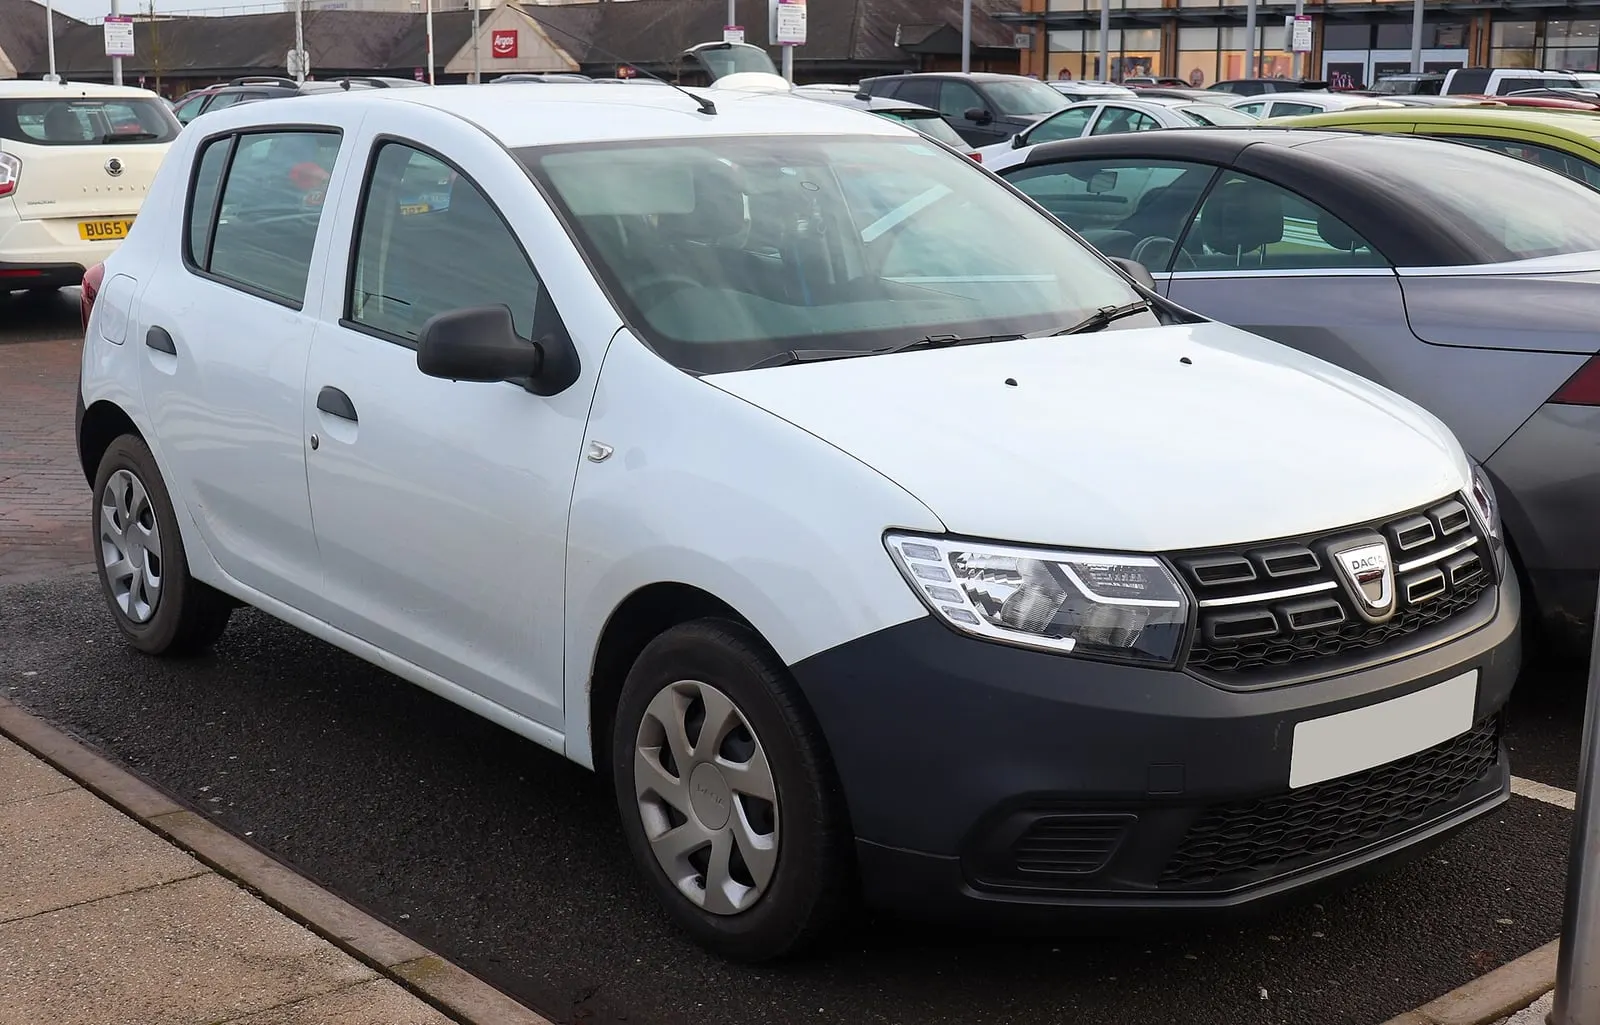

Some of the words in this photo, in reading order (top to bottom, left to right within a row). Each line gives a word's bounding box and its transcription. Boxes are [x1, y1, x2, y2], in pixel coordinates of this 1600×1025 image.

[494, 34, 514, 48] Argos
[85, 222, 122, 236] BU65
[1351, 555, 1384, 570] DACIA
